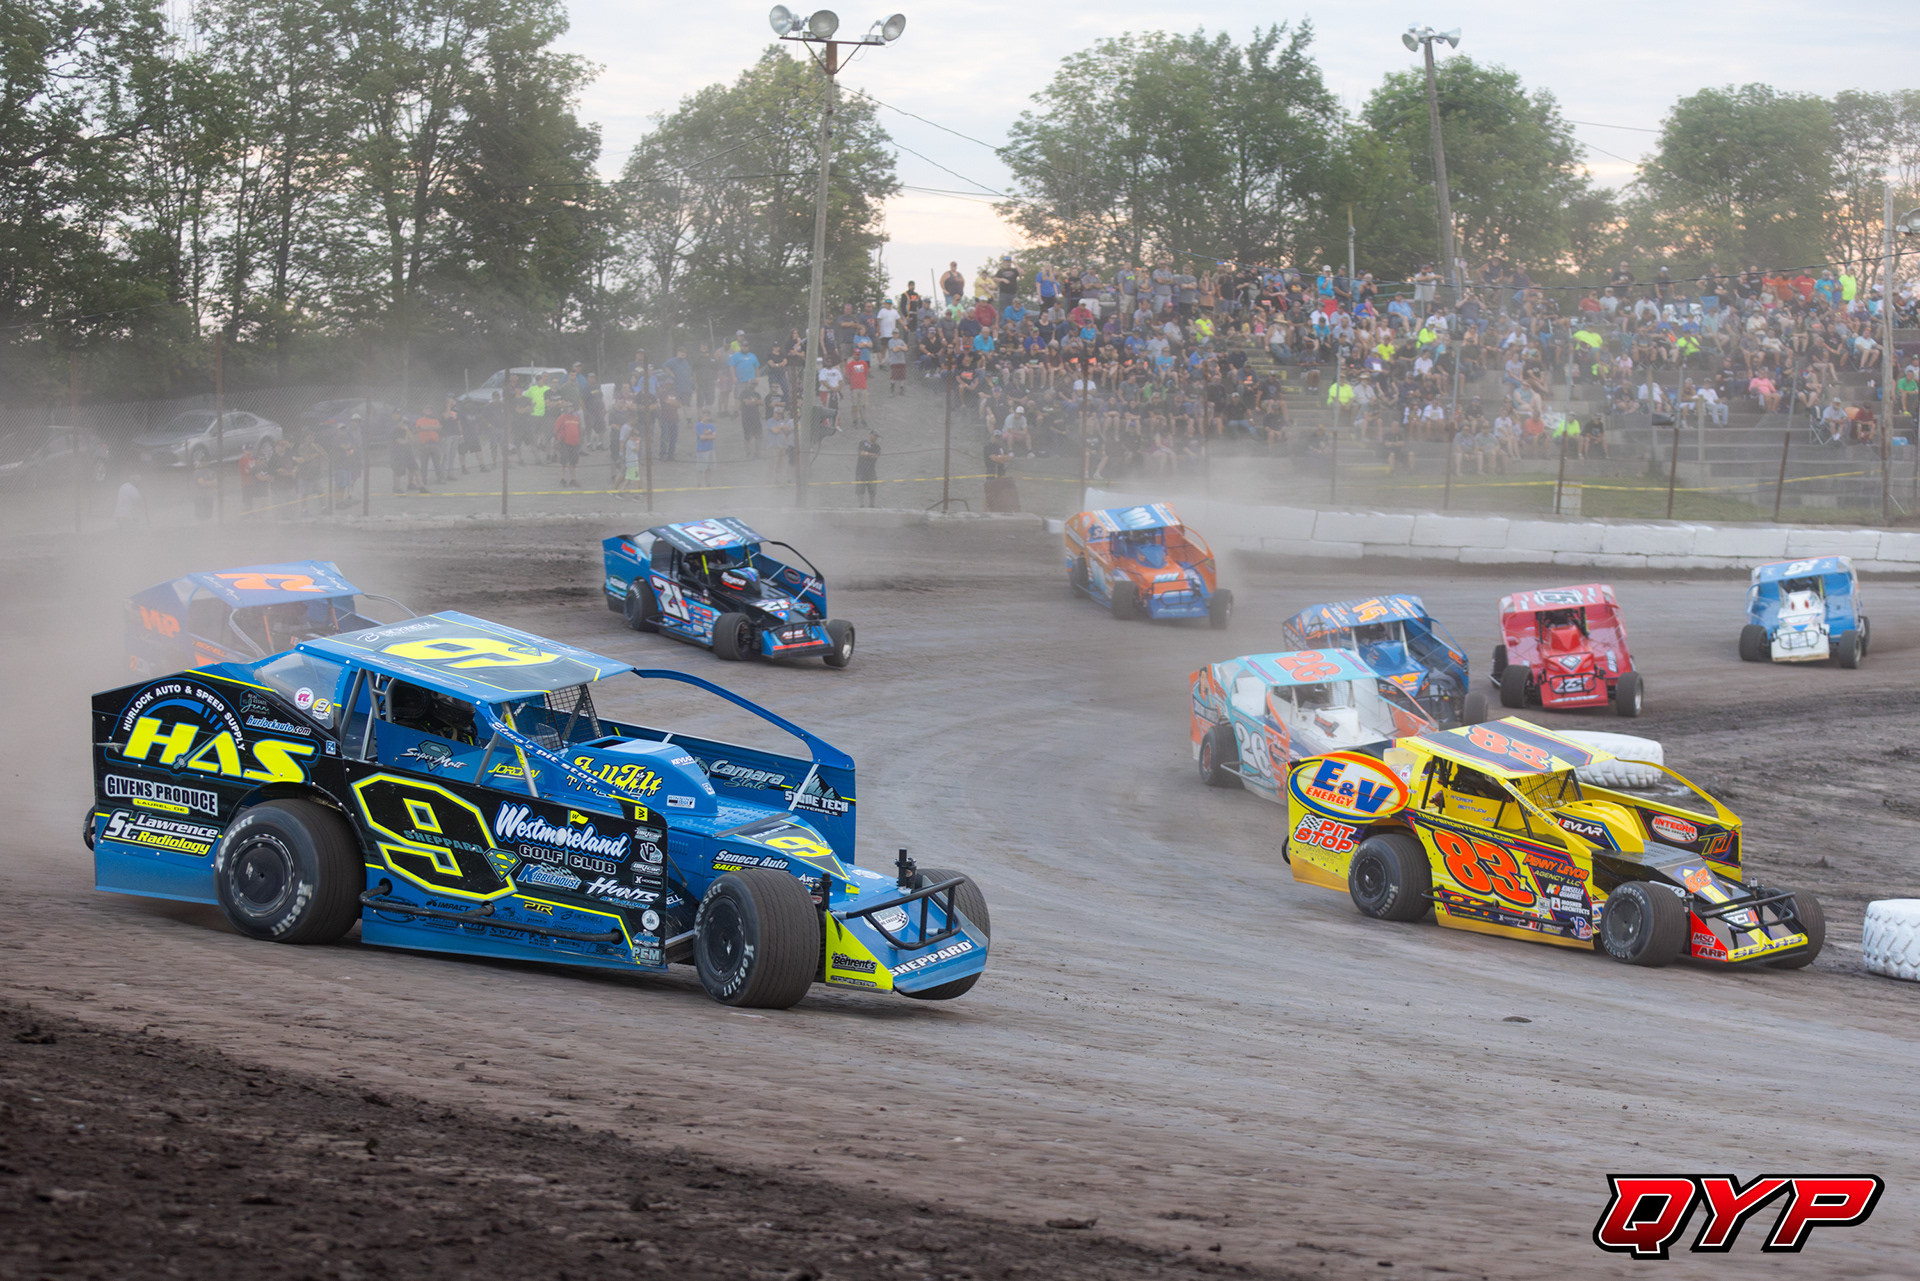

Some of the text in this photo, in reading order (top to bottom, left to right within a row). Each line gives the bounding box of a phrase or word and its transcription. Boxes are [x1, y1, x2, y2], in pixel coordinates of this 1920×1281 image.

[651, 575, 691, 623] 21
[380, 638, 563, 669] 9
[1274, 650, 1342, 681] 26
[123, 684, 246, 751] HURLOCK AUTO & SPEED SUPPLY
[246, 714, 312, 736] hurlockauto.com
[122, 715, 315, 784] HAS
[1235, 720, 1272, 779] 26
[709, 759, 786, 786] Camara
[105, 775, 217, 815] GIVENS PRODUCE
[1304, 786, 1355, 807] ENERGY
[1310, 757, 1397, 815] E&V
[821, 797, 849, 813] TECH
[104, 810, 219, 840] St. Lawrence
[352, 772, 517, 900] 9
[494, 803, 629, 859] Westmoreland
[1318, 819, 1356, 840] PIT
[1557, 817, 1605, 837] KEVLAR
[1653, 816, 1697, 834] INTEGRA
[137, 830, 211, 856] Radiology
[403, 829, 484, 854] SHEPPARD
[764, 836, 834, 857] 9
[1294, 826, 1354, 852] STOP
[518, 843, 617, 876] GOLF CLUB
[712, 862, 743, 872] SALES
[715, 849, 789, 870] Seneca Auto
[1433, 829, 1536, 906] 83
[1522, 853, 1590, 880] PENNY LEVOS
[516, 863, 582, 890] KIBBLEHOUSE
[1534, 869, 1582, 887] AGENCY LLC
[437, 901, 471, 912] IMPACT
[1561, 904, 1591, 915] ARCHITECTS
[1693, 932, 1715, 944] MSD
[1733, 937, 1804, 960] SEARS
[833, 955, 876, 970] Behrent's
[888, 939, 974, 977] SHEPPARD
[1698, 946, 1727, 958] ARP
